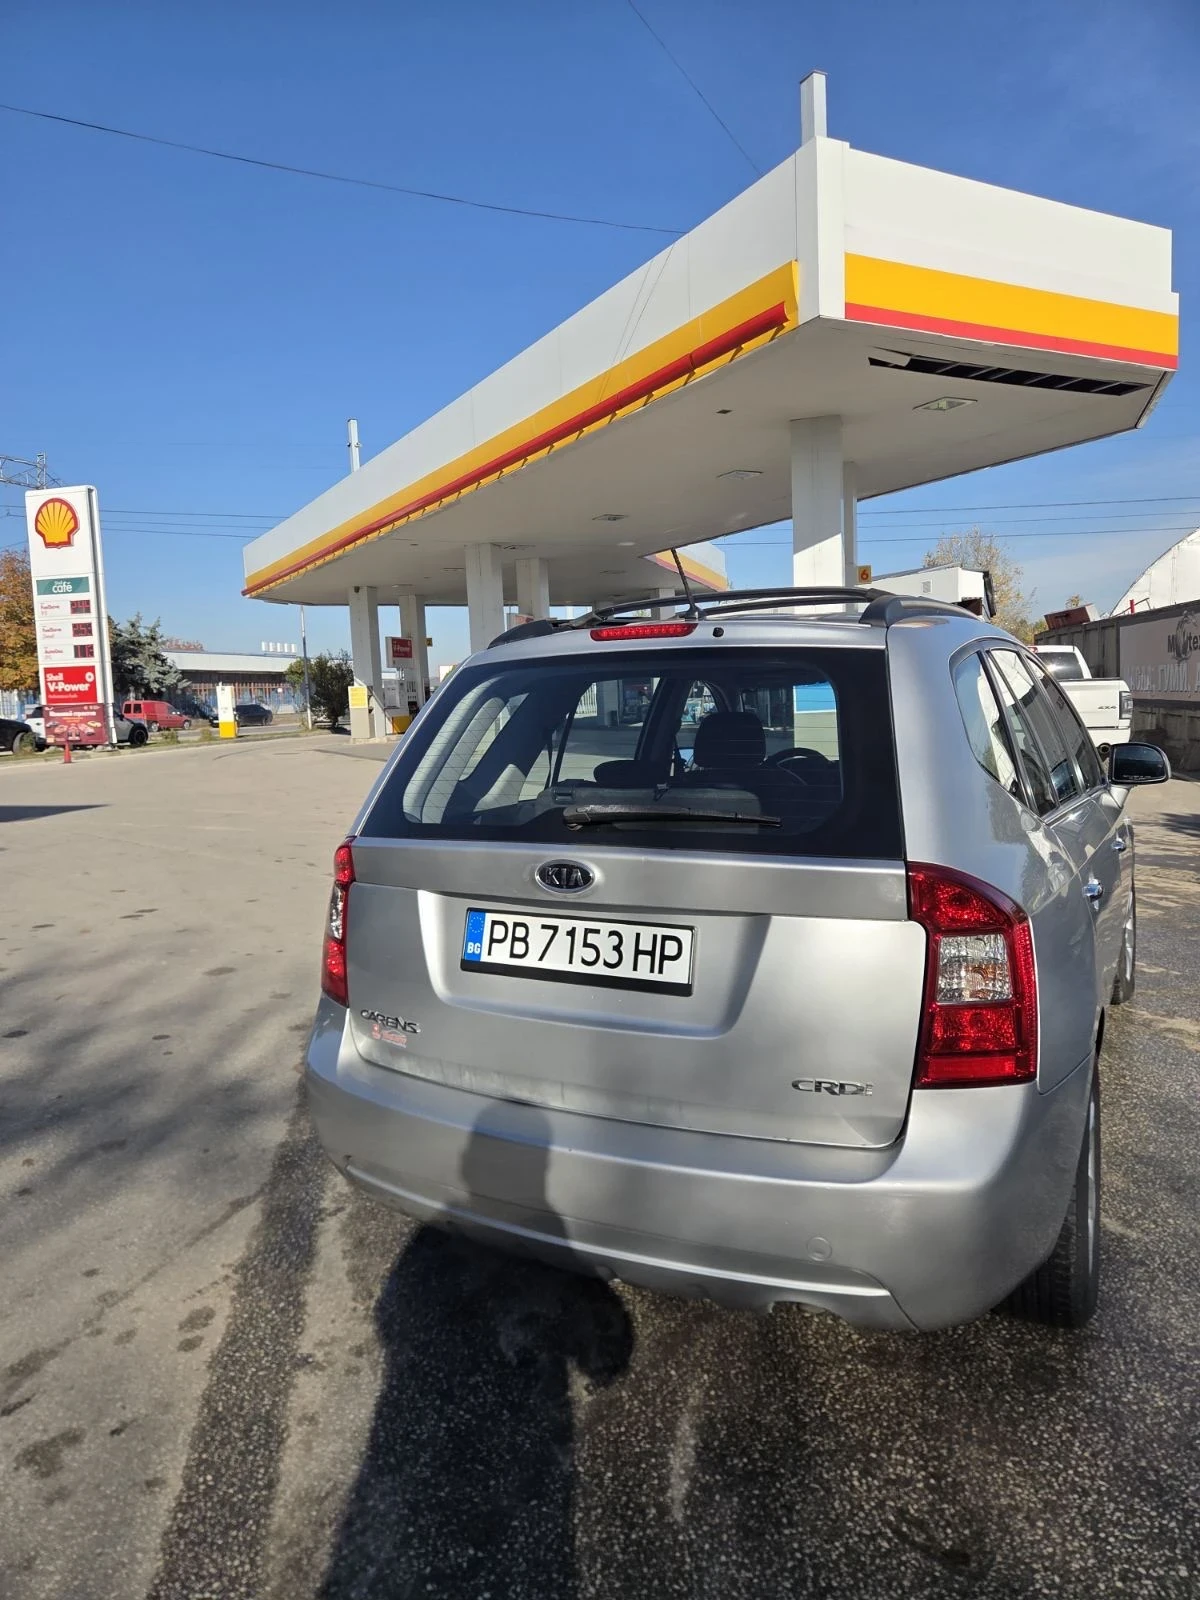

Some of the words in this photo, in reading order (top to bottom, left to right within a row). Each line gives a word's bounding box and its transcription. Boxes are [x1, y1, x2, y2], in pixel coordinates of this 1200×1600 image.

[861, 569, 869, 580] 6
[46, 672, 64, 681] Shell
[47, 682, 90, 692] V-Power
[545, 867, 584, 886] KIA
[467, 942, 480, 954] BG
[487, 920, 529, 959] PB
[537, 924, 624, 969] 7153
[632, 932, 683, 975] HP
[361, 1010, 420, 1033] CARENS
